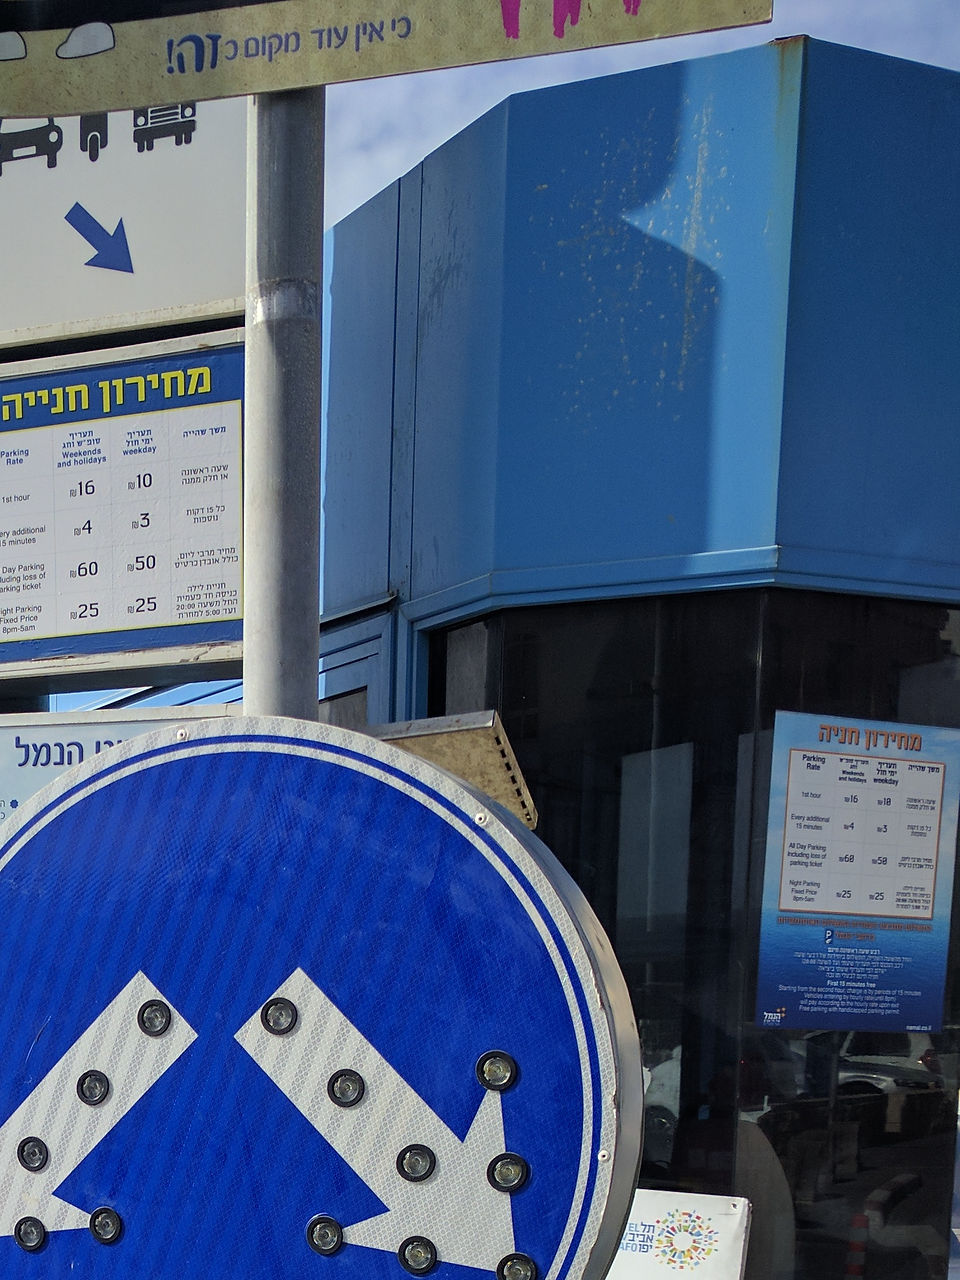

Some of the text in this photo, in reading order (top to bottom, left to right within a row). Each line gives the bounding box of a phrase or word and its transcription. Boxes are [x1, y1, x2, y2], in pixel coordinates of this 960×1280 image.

[390, 15, 412, 38] כי
[310, 25, 348, 49] עוד
[354, 20, 384, 52] אין
[243, 31, 300, 62] מקום
[1, 366, 211, 421] מחירון חנייה
[0, 448, 29, 458] Parking
[61, 448, 101, 458] Weekends
[121, 446, 156, 456] weekday
[6, 457, 23, 465] Rate
[57, 456, 107, 468] and holidays
[10, 525, 45, 536] additional
[8, 537, 37, 546] minutes
[1, 566, 17, 574] Day
[16, 563, 45, 572] Parking
[38, 571, 46, 579] of
[21, 582, 41, 590] ticket
[15, 605, 42, 613] Parking
[20, 614, 38, 622] Price
[818, 724, 922, 751] מחירון חניה
[14, 735, 84, 767] הנמל
[802, 754, 826, 764] Parking
[806, 762, 820, 770] Rate
